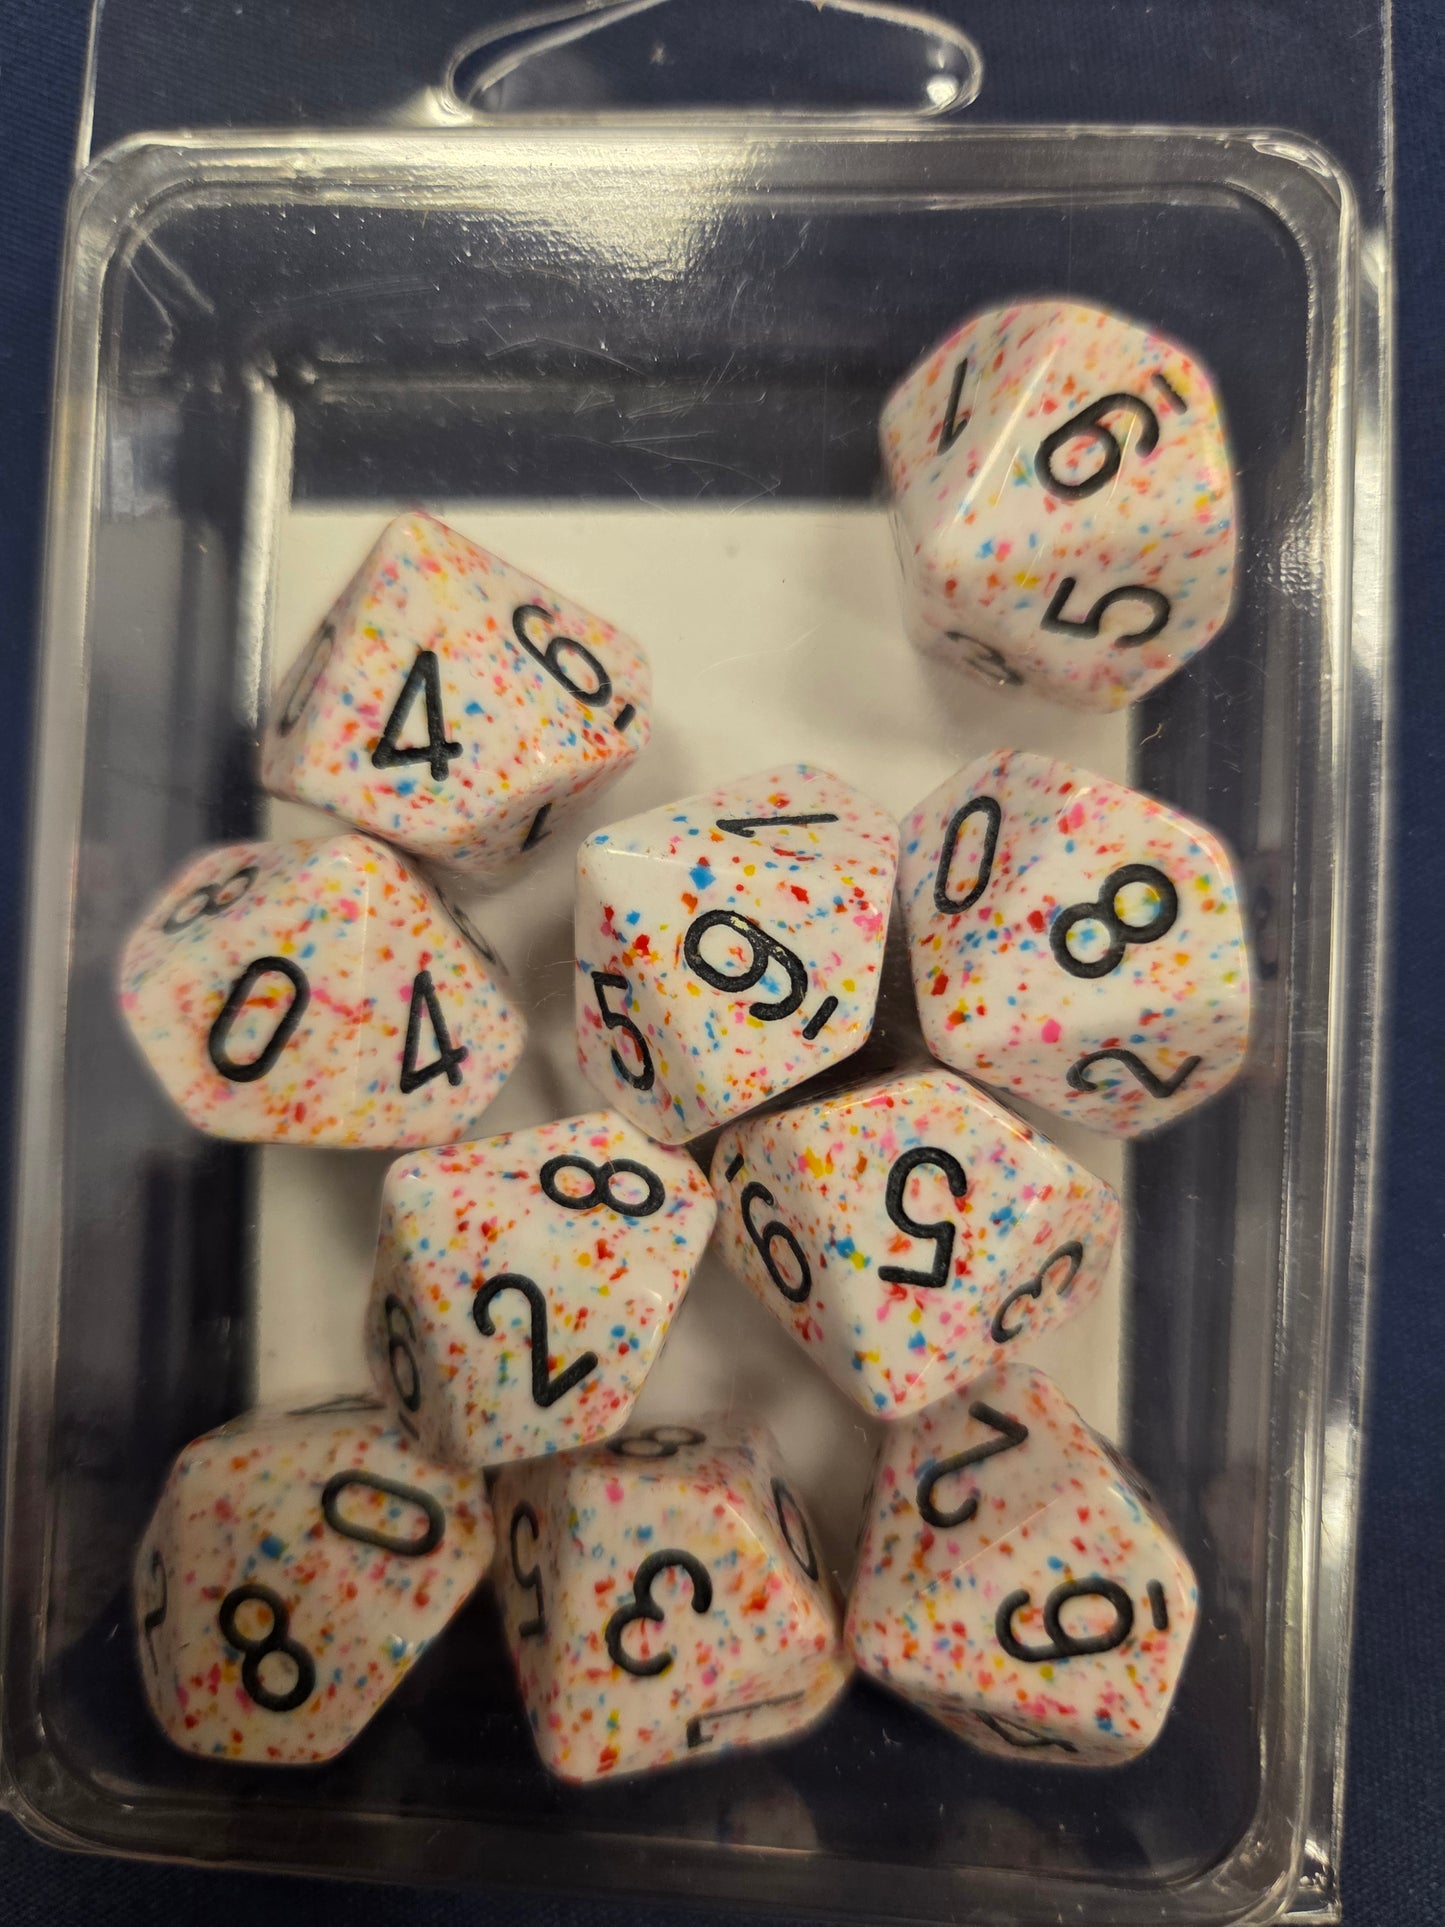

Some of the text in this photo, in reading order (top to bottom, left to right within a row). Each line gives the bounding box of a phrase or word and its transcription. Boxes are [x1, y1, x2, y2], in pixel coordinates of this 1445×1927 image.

[512, 605, 635, 733] 6
[1040, 576, 1171, 648] 5
[372, 650, 464, 781] 4
[716, 813, 839, 838] 1
[933, 796, 1001, 915] 0
[163, 866, 259, 934] 8
[1049, 863, 1178, 979] 8
[208, 956, 311, 1083] 0
[400, 970, 470, 1094] 4
[591, 971, 655, 1091] 5
[684, 909, 839, 1040] 9
[1066, 1048, 1202, 1098] 2
[540, 1154, 666, 1217] 8
[878, 1146, 967, 1288] 5
[473, 1272, 599, 1408] 2
[991, 1240, 1084, 1343] 3
[321, 1469, 446, 1556] 0
[917, 1402, 1029, 1528] 2
[510, 1501, 546, 1638] 5
[605, 1548, 713, 1676] 3
[995, 1578, 1169, 1662] 6
[218, 1583, 316, 1712] 8
